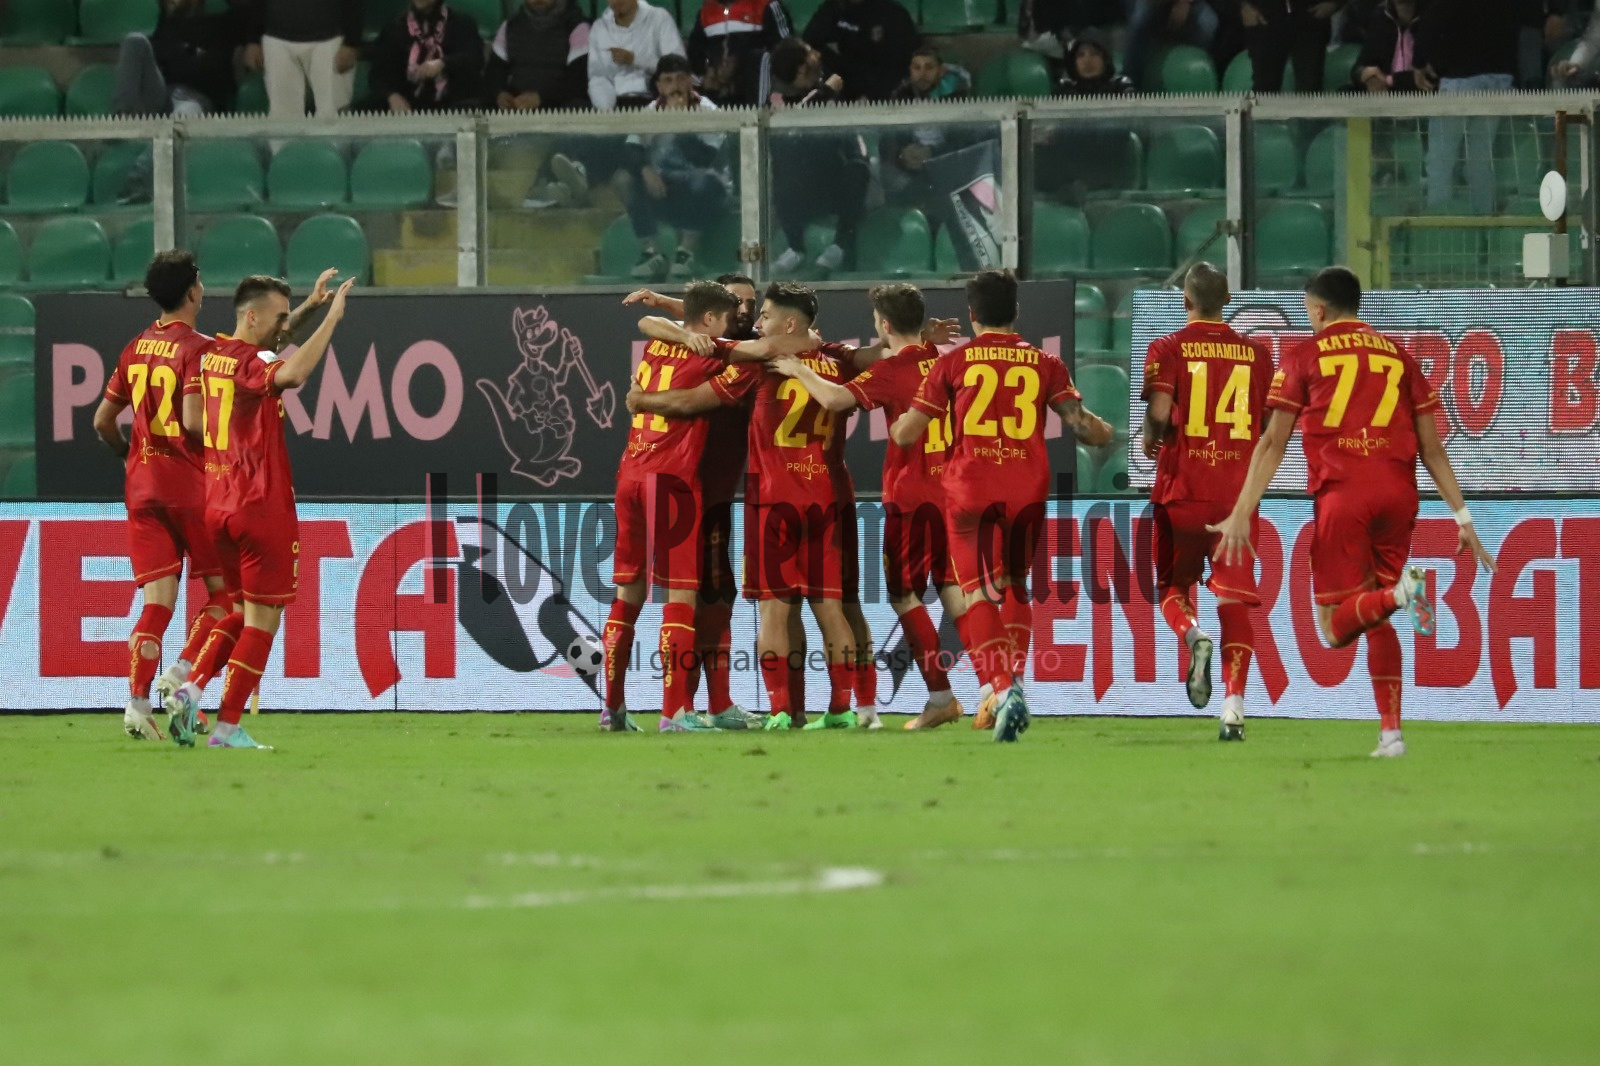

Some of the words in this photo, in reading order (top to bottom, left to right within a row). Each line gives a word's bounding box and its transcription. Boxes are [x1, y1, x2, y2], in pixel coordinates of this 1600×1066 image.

[135, 338, 180, 359] VEROLI
[965, 346, 1040, 365] BRIGHENTI
[1181, 341, 1255, 362] SCOGNAMILLO
[1316, 332, 1398, 355] KATSERIS
[127, 363, 181, 438] 72
[773, 377, 836, 451] 24
[963, 363, 1041, 441] 23
[1184, 360, 1252, 441] 14
[1318, 353, 1405, 428] 77
